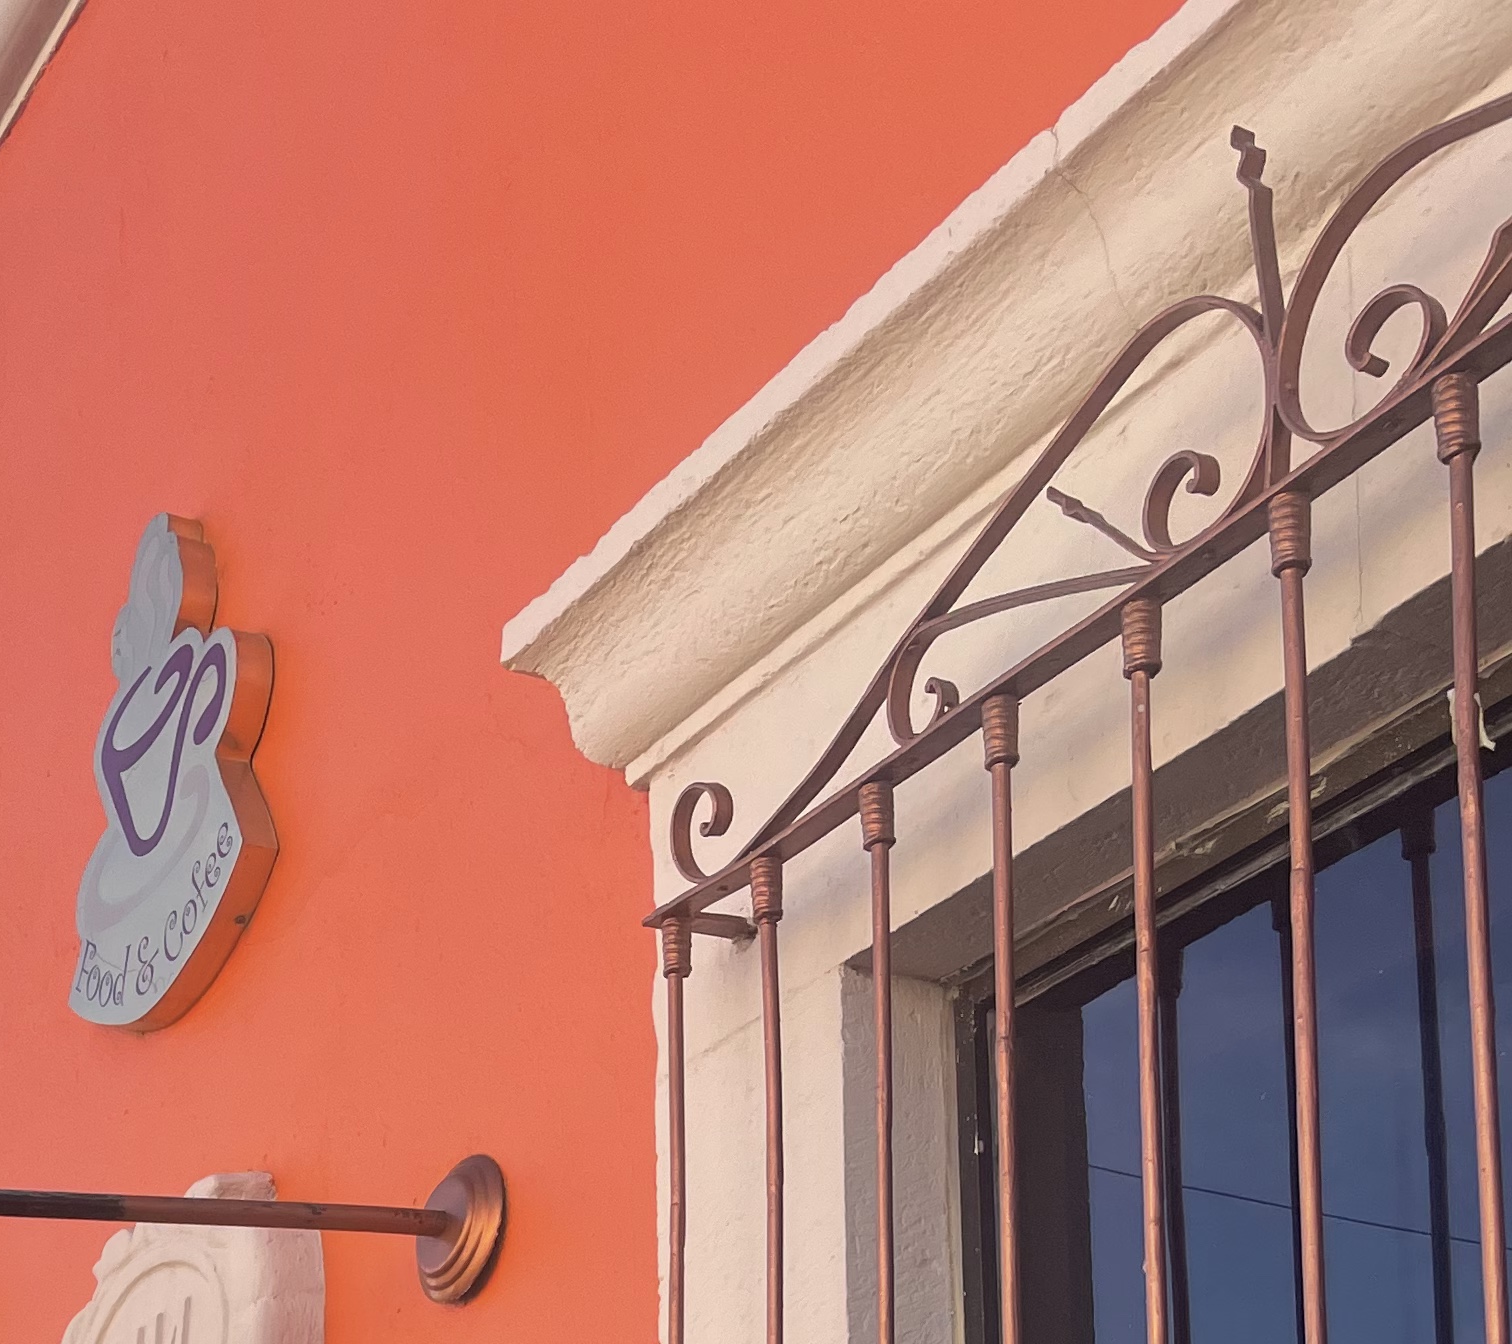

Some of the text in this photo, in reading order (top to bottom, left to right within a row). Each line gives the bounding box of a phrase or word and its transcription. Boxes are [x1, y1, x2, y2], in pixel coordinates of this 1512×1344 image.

[75, 822, 233, 1008] Food & Cofee
